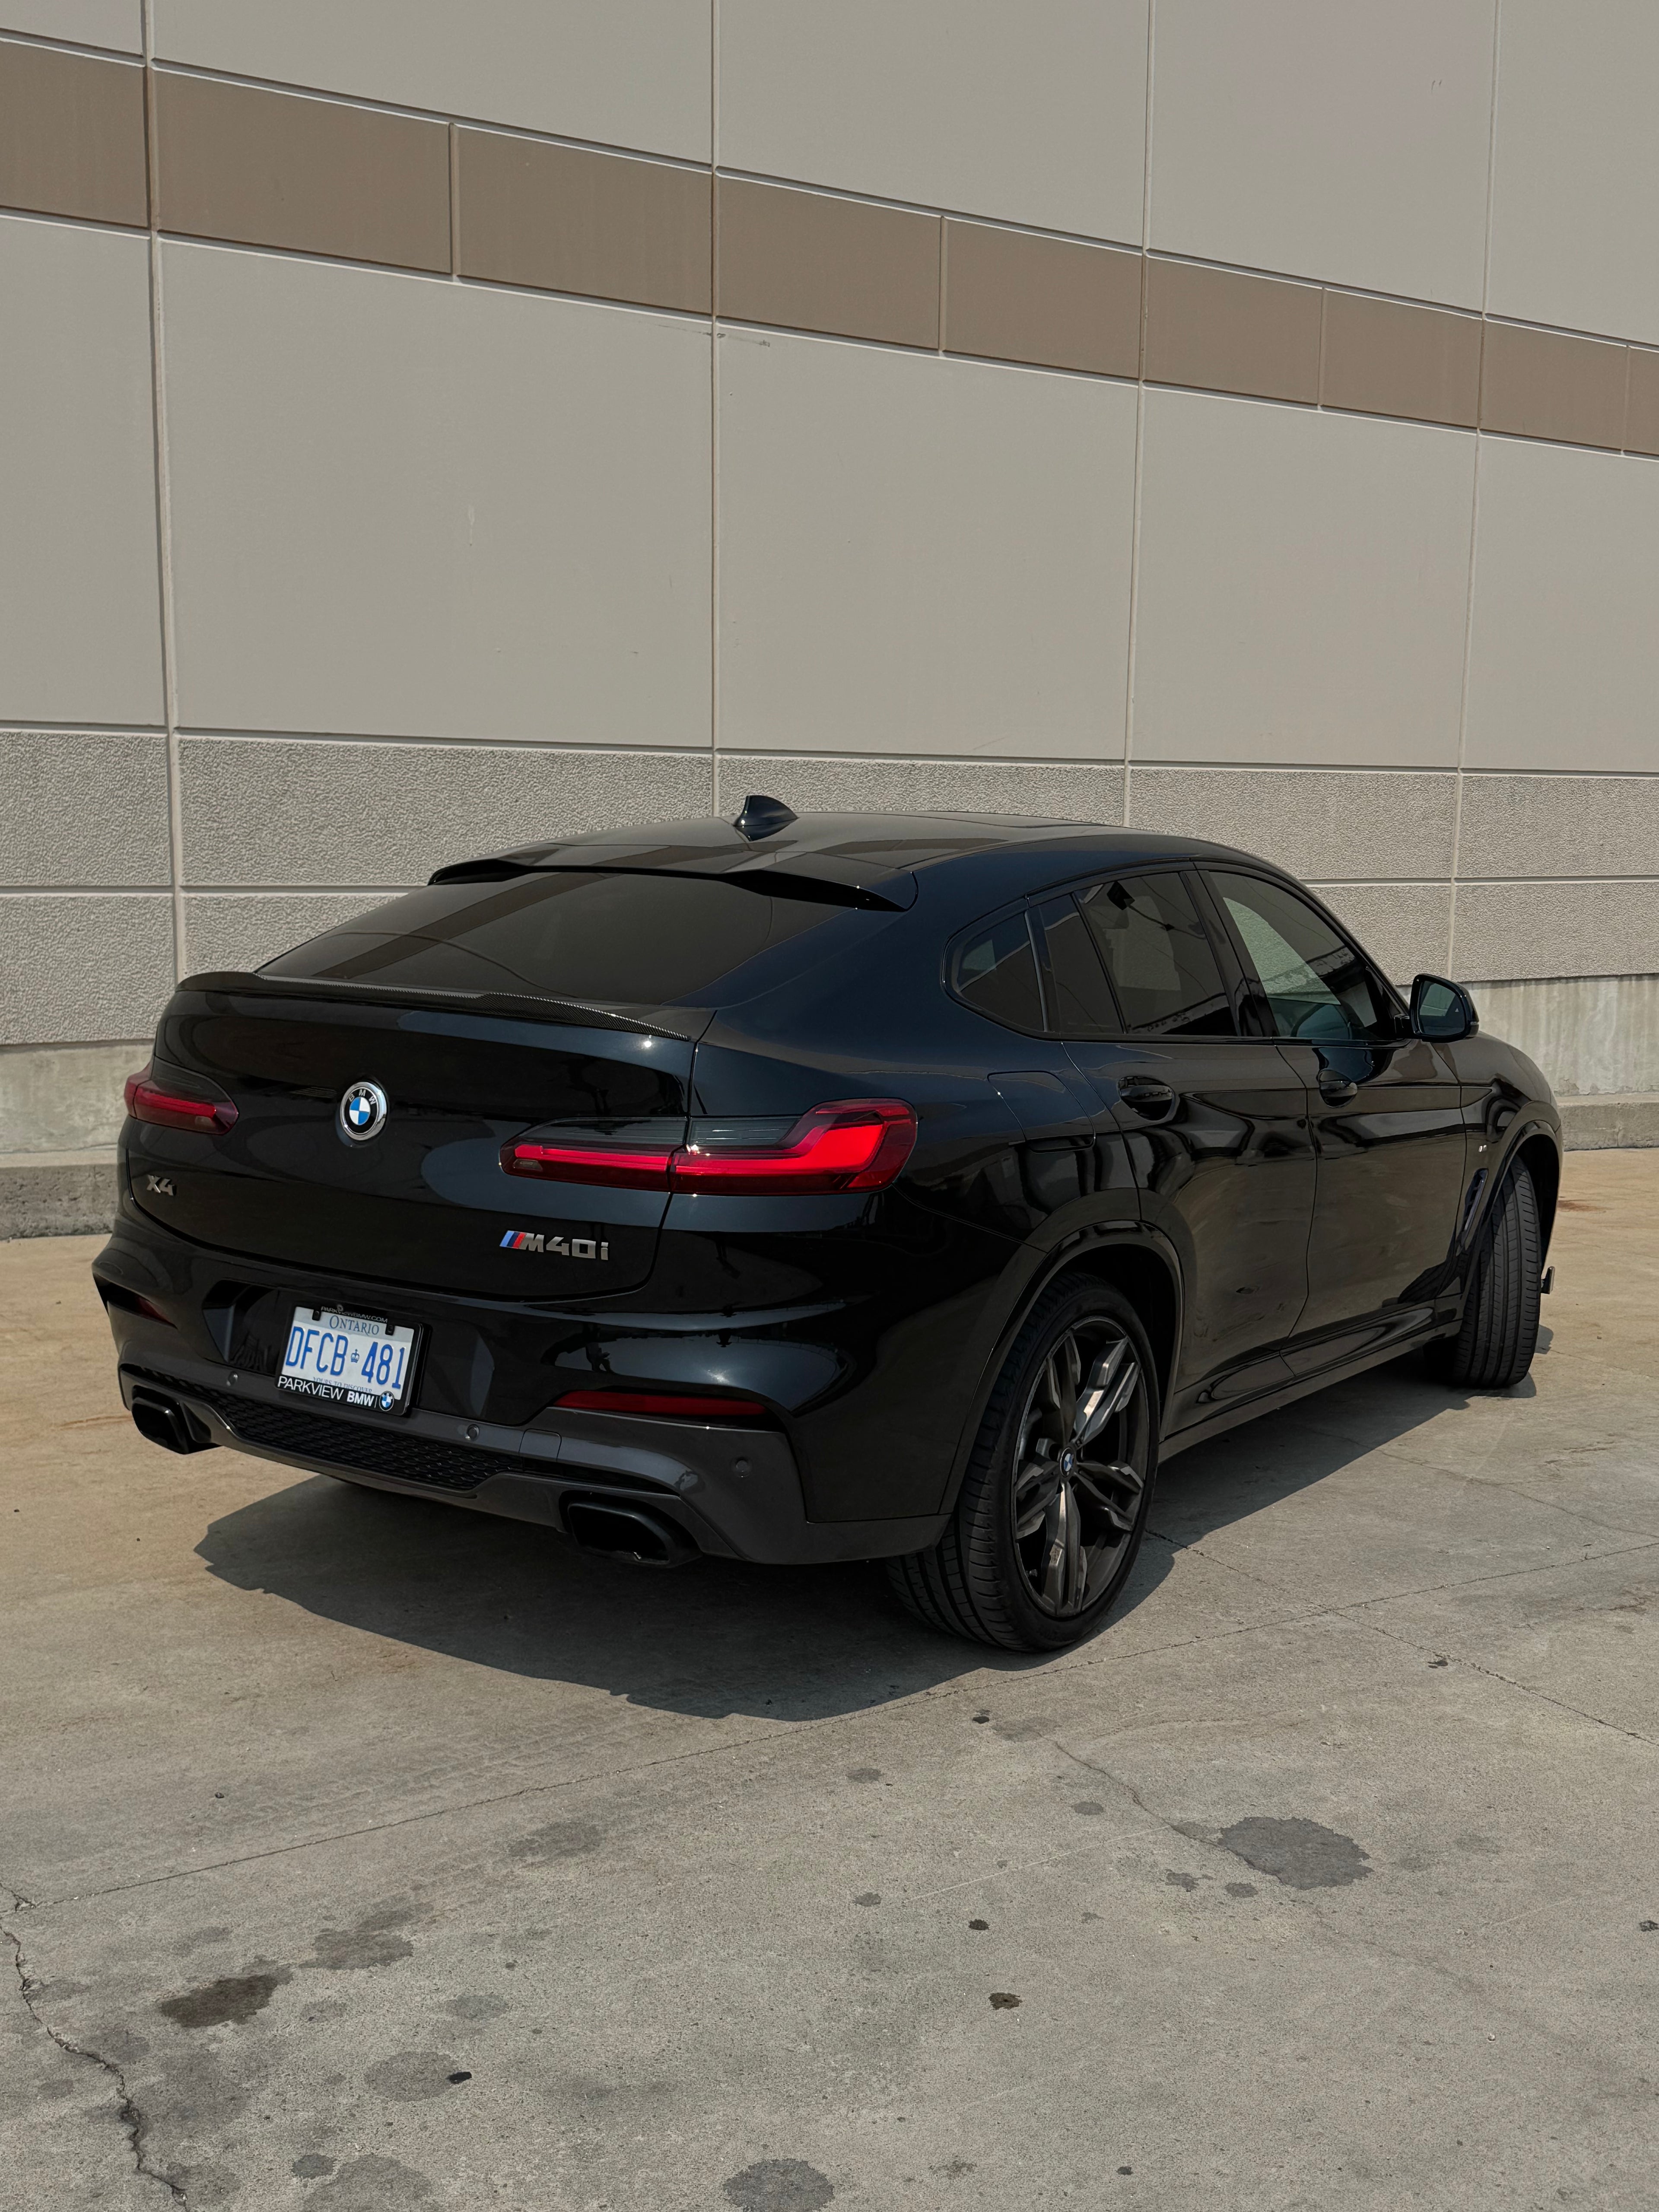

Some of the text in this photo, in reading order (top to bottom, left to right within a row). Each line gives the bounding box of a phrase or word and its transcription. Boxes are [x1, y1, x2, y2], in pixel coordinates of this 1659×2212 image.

[349, 1089, 376, 1105] BMW
[146, 1174, 175, 1196] X4
[518, 1232, 608, 1260] M40i
[330, 1315, 379, 1336] ONTARIO
[286, 1326, 405, 1389] DFCB 481
[277, 1376, 374, 1406] PARKVIEW BMW
